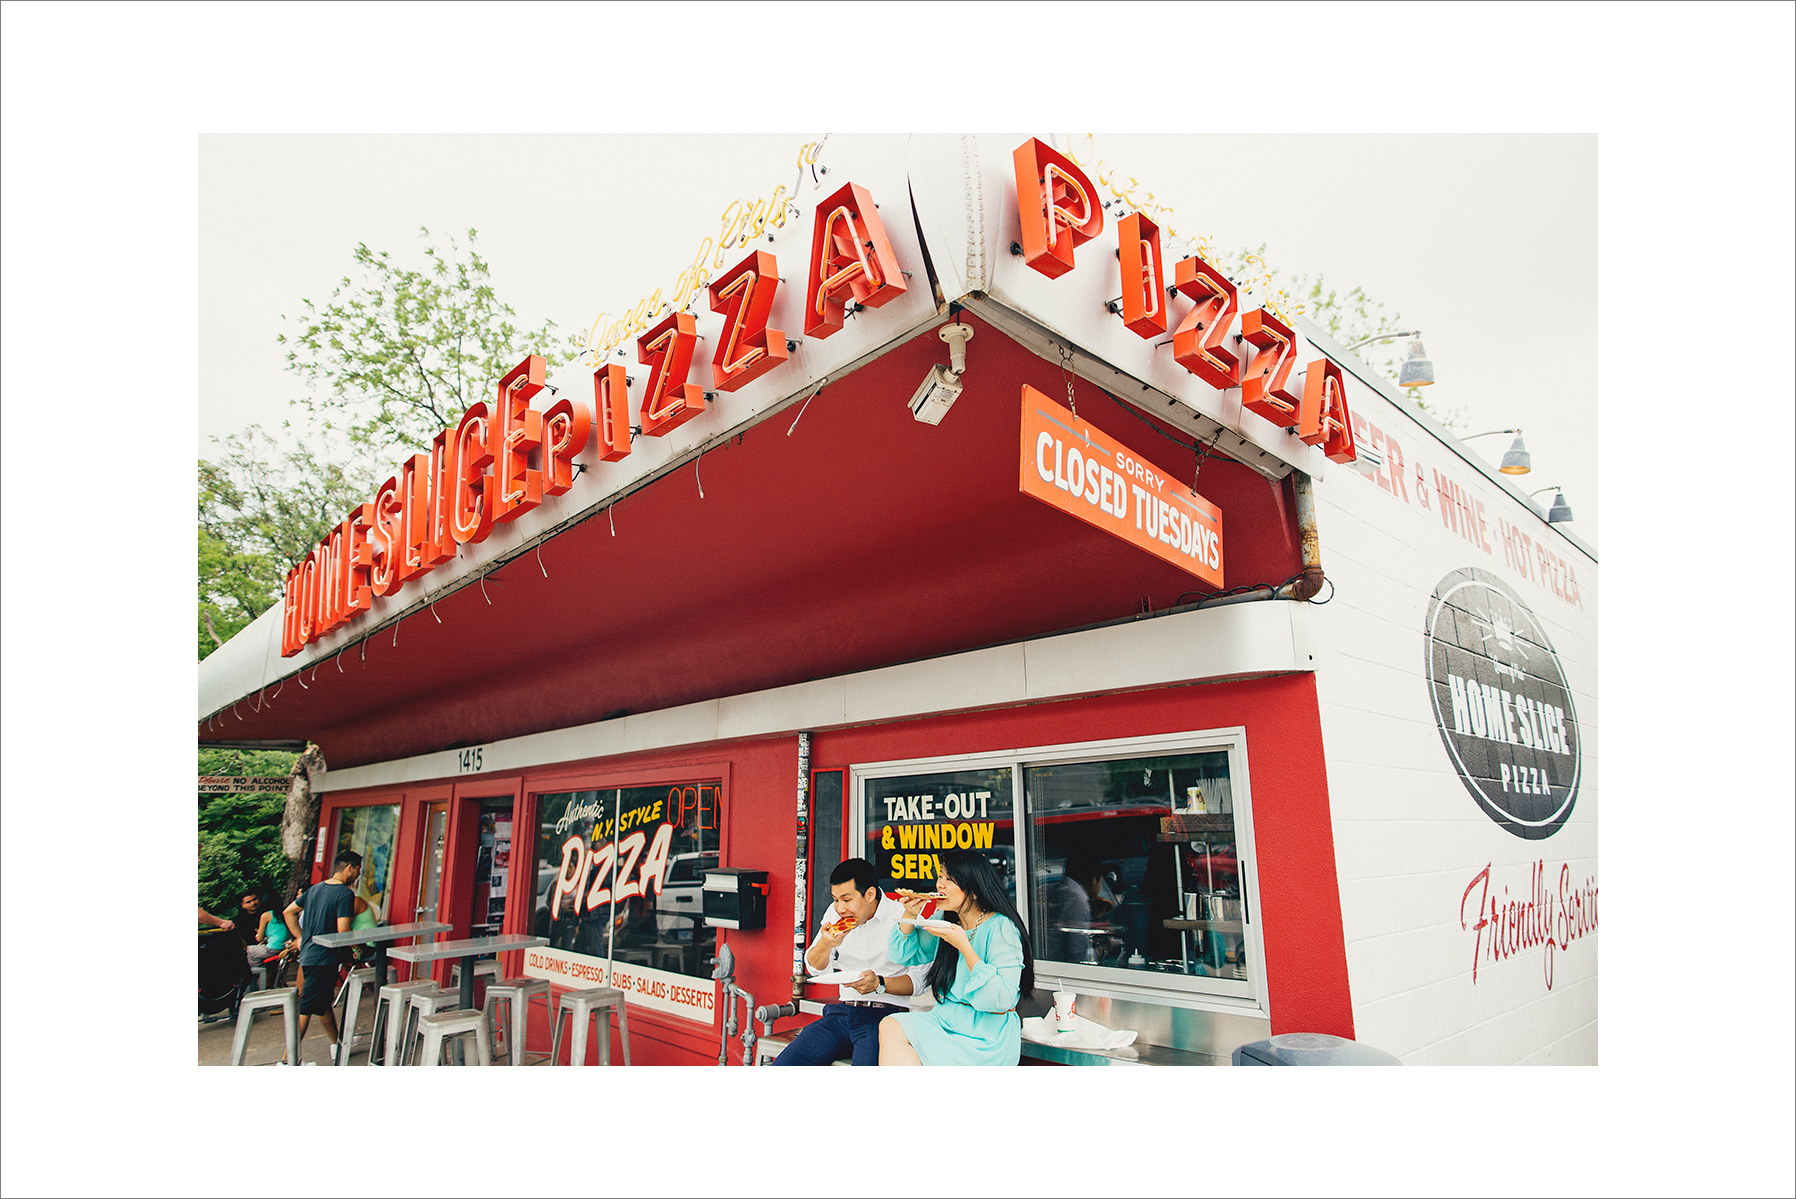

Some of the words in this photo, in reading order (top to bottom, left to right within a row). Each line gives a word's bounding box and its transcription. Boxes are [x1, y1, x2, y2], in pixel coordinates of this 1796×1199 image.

[1013, 137, 1357, 464] PIZZA
[542, 181, 908, 497] PIZZA
[1116, 451, 1165, 493] SORRY
[1036, 431, 1127, 520] CLOSED
[1132, 483, 1220, 571] TUESDAYS
[1350, 409, 1410, 505] EER
[1415, 461, 1432, 511] &
[1432, 467, 1492, 556] WINE
[1498, 515, 1536, 582] HOT
[1535, 540, 1584, 611] PIZZA
[232, 777, 247, 785] NO
[250, 777, 291, 785] ALCOHOL
[458, 747, 484, 773] 1415
[1500, 762, 1552, 796] PIZZA
[233, 784, 255, 792] THIS
[258, 784, 291, 792] POINT
[883, 791, 991, 821] TAKE-OUT
[556, 799, 604, 834] Authentic
[591, 818, 615, 842] N.Y.
[619, 800, 663, 832] STYLE
[881, 824, 896, 850] &
[898, 822, 995, 850] WINDOW
[551, 821, 674, 922] PIZZA
[890, 853, 943, 879] SERV
[1460, 858, 1556, 991] Friendly
[528, 952, 543, 969] COLD
[545, 957, 568, 975] DRINKS
[571, 962, 603, 984] ESPRESSO
[612, 972, 632, 990] SUBS
[636, 977, 666, 999] SALADS
[670, 985, 714, 1010] DESSERTS
